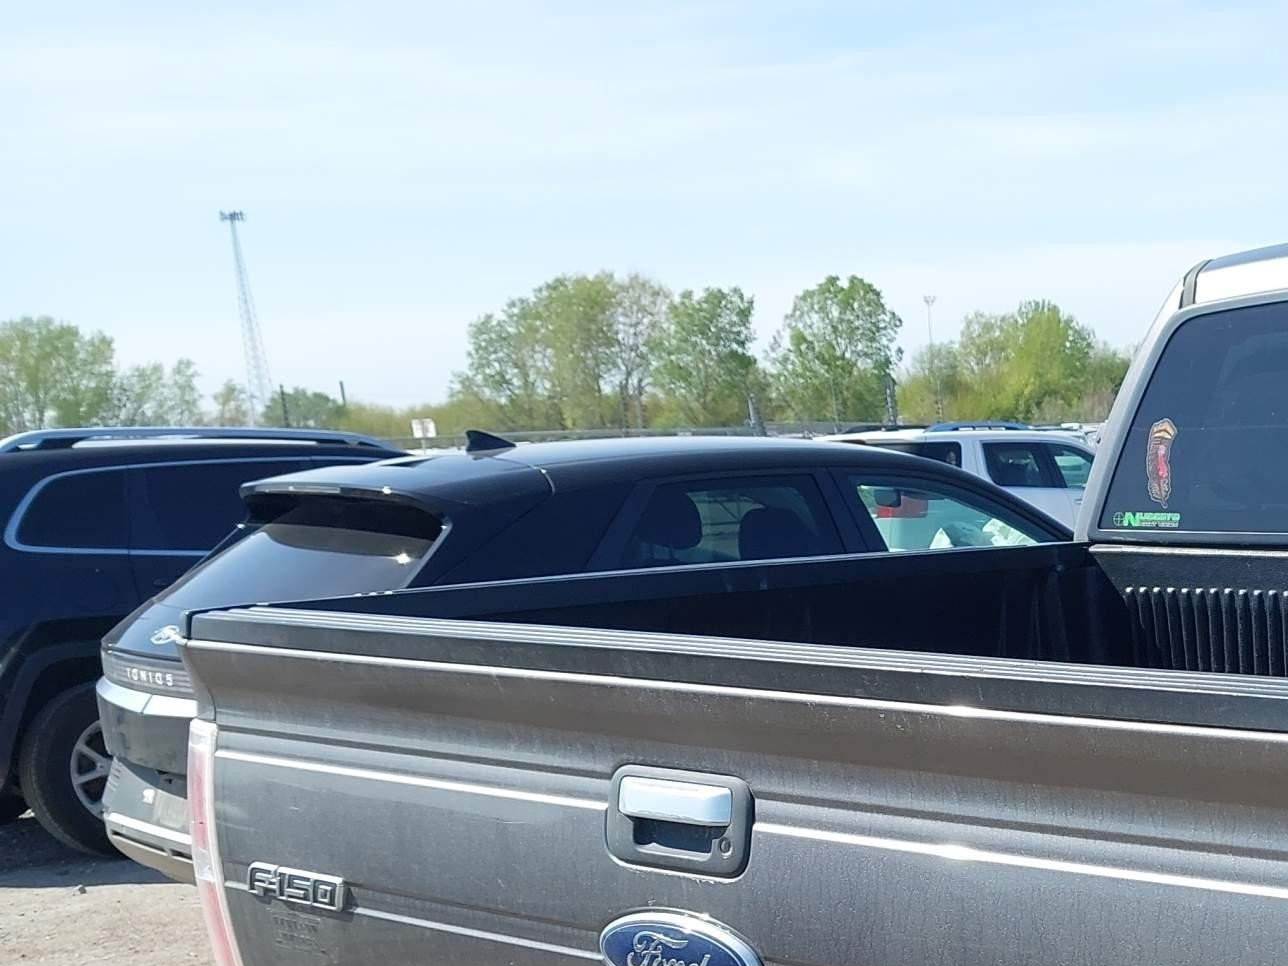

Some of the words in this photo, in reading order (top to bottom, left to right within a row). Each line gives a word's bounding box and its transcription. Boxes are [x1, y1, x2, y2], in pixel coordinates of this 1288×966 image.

[126, 667, 163, 686] IONIQ
[165, 673, 174, 687] 5
[247, 861, 344, 912] F-150
